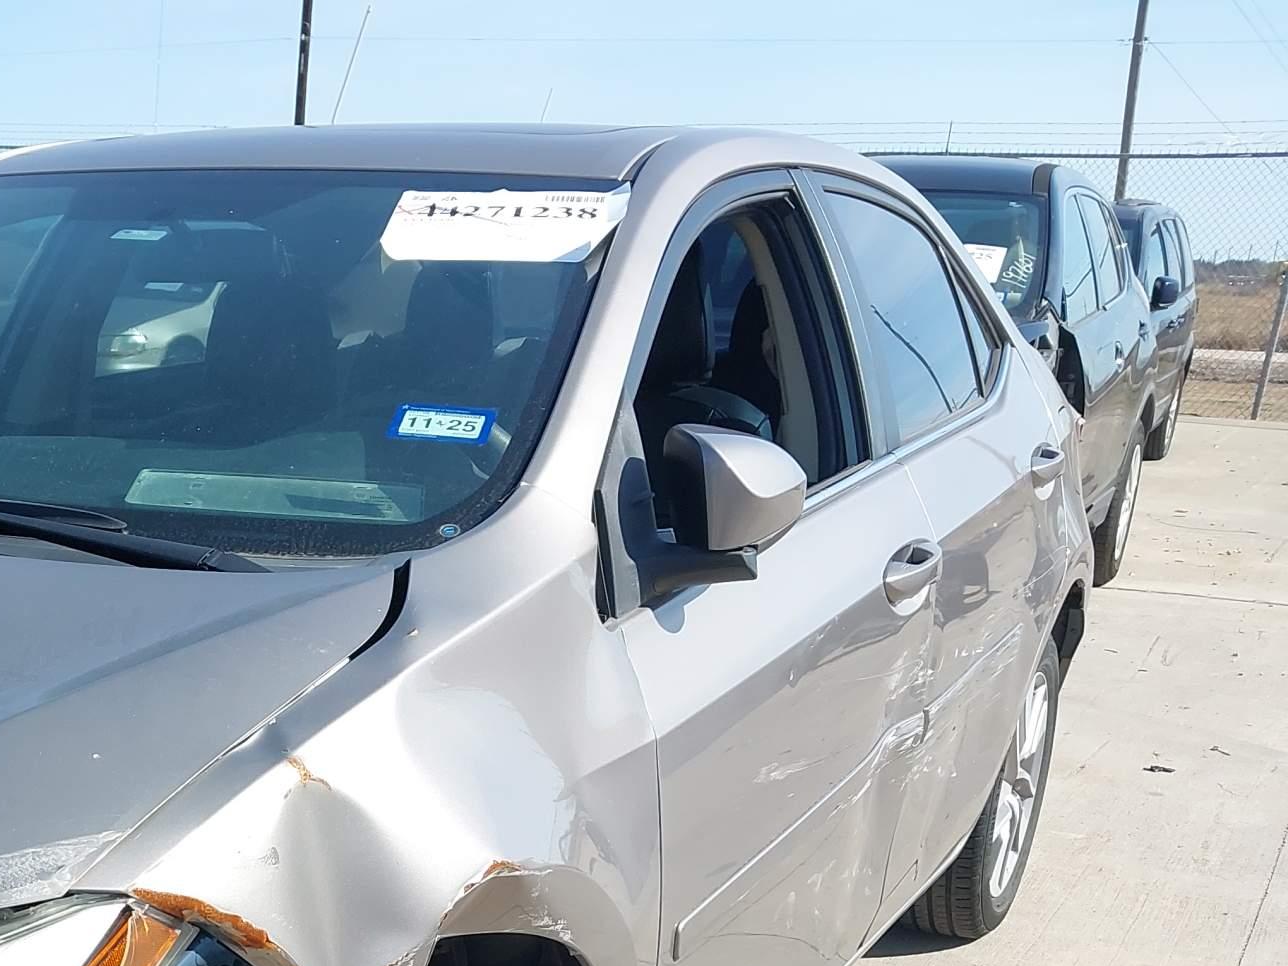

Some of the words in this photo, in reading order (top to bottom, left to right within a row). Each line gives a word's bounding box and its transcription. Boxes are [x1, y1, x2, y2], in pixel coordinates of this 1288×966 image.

[416, 202, 600, 220] 44271238
[407, 416, 433, 429] 11
[445, 419, 479, 433] 25
